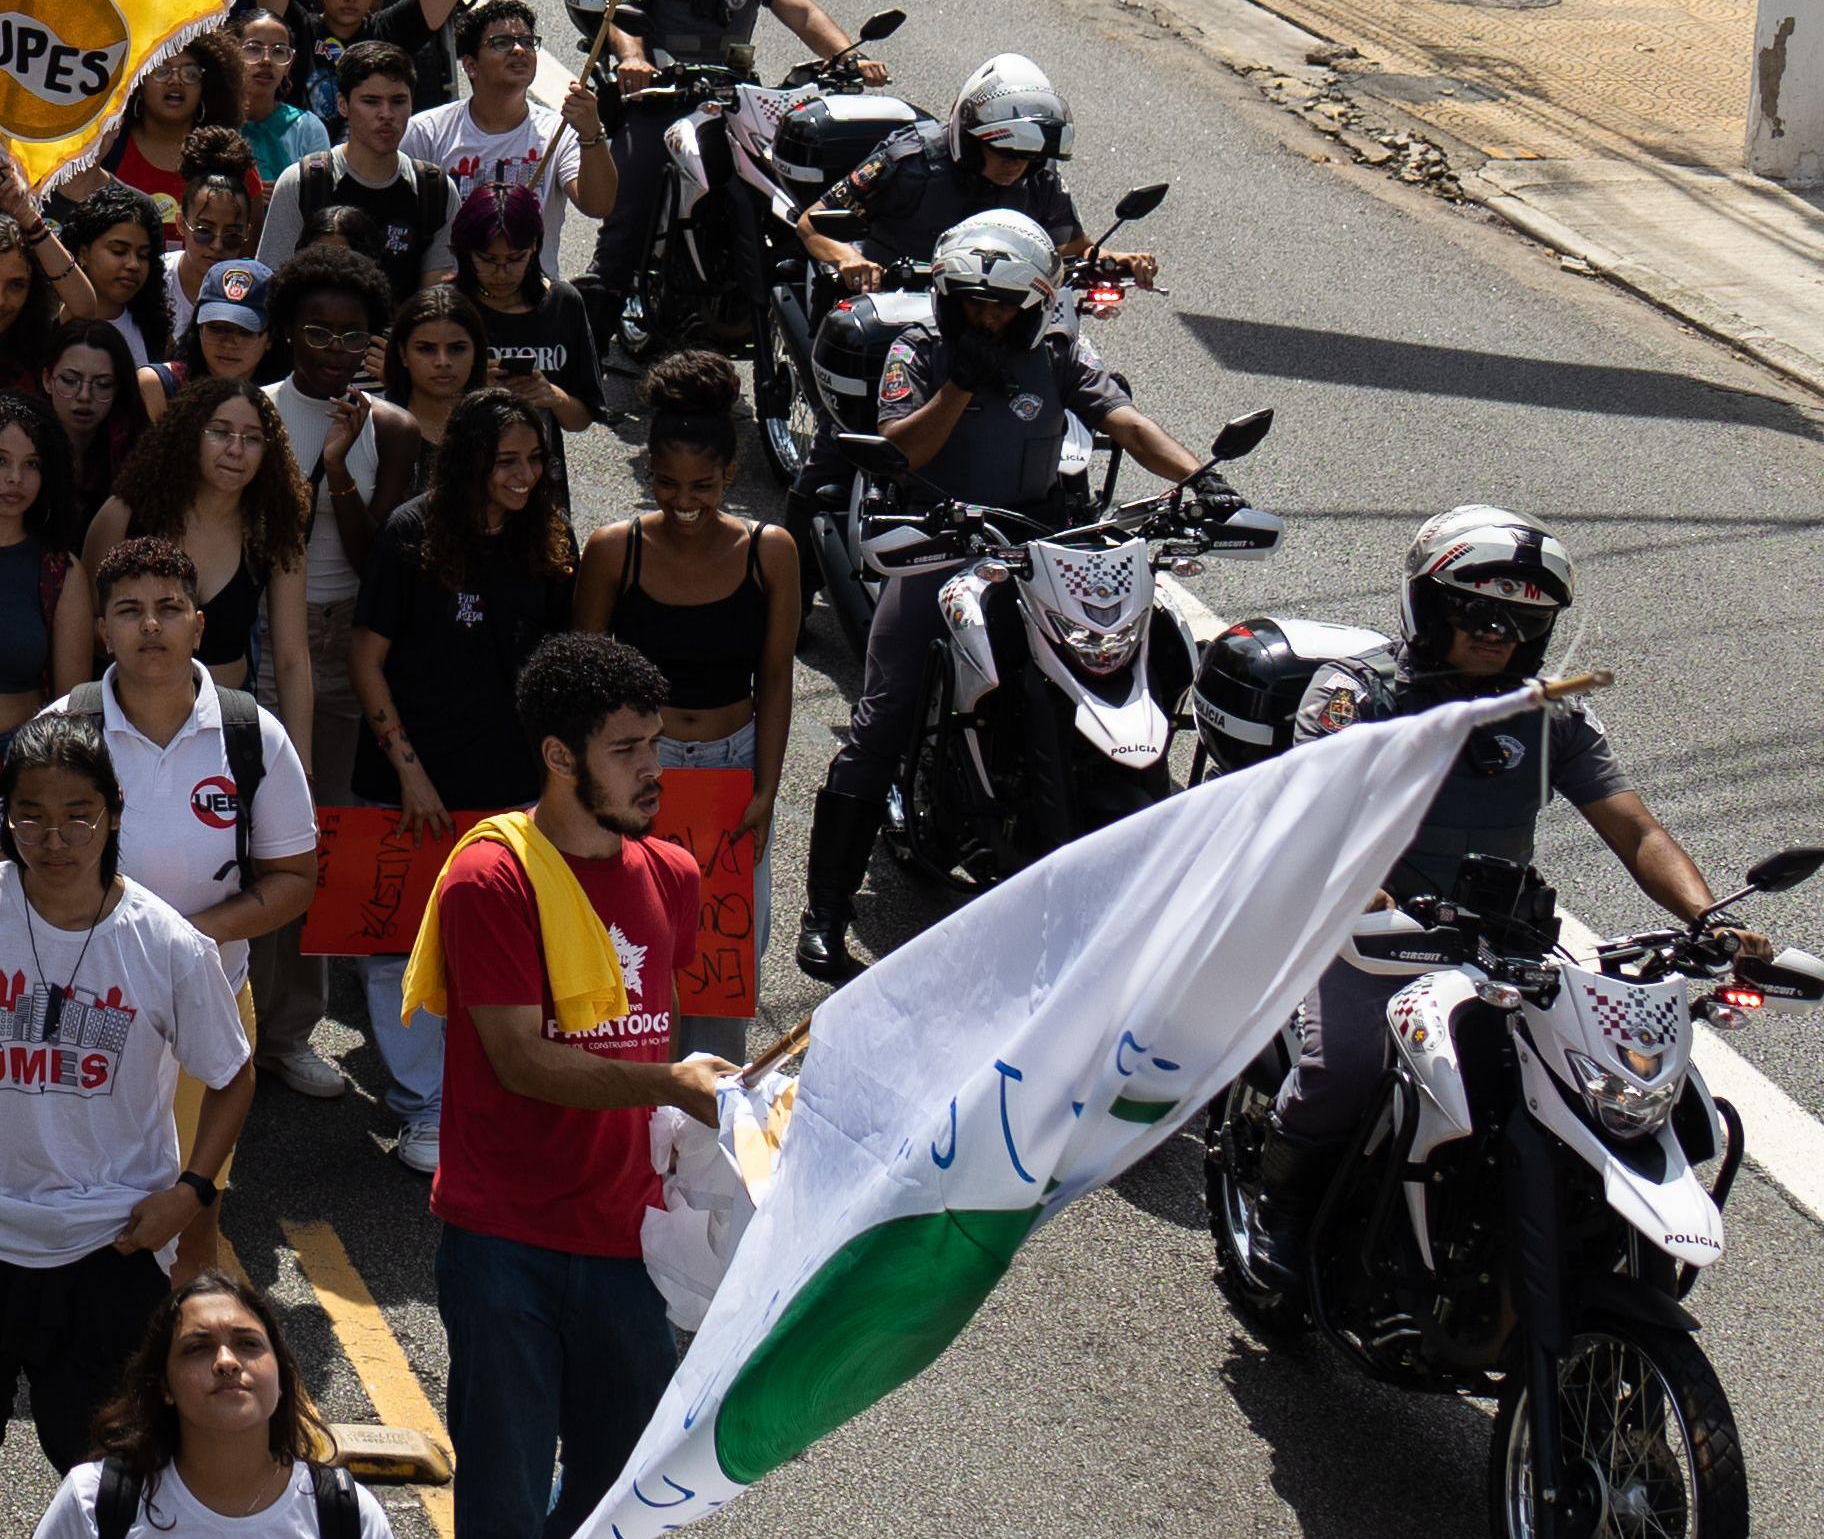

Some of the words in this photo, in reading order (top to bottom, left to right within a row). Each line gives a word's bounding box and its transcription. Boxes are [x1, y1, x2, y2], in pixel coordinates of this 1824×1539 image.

[1110, 742, 1159, 757] POLÍCIA
[1398, 949, 1443, 963] CIRCUIT
[1662, 1233, 1723, 1252] POLÍCIA
